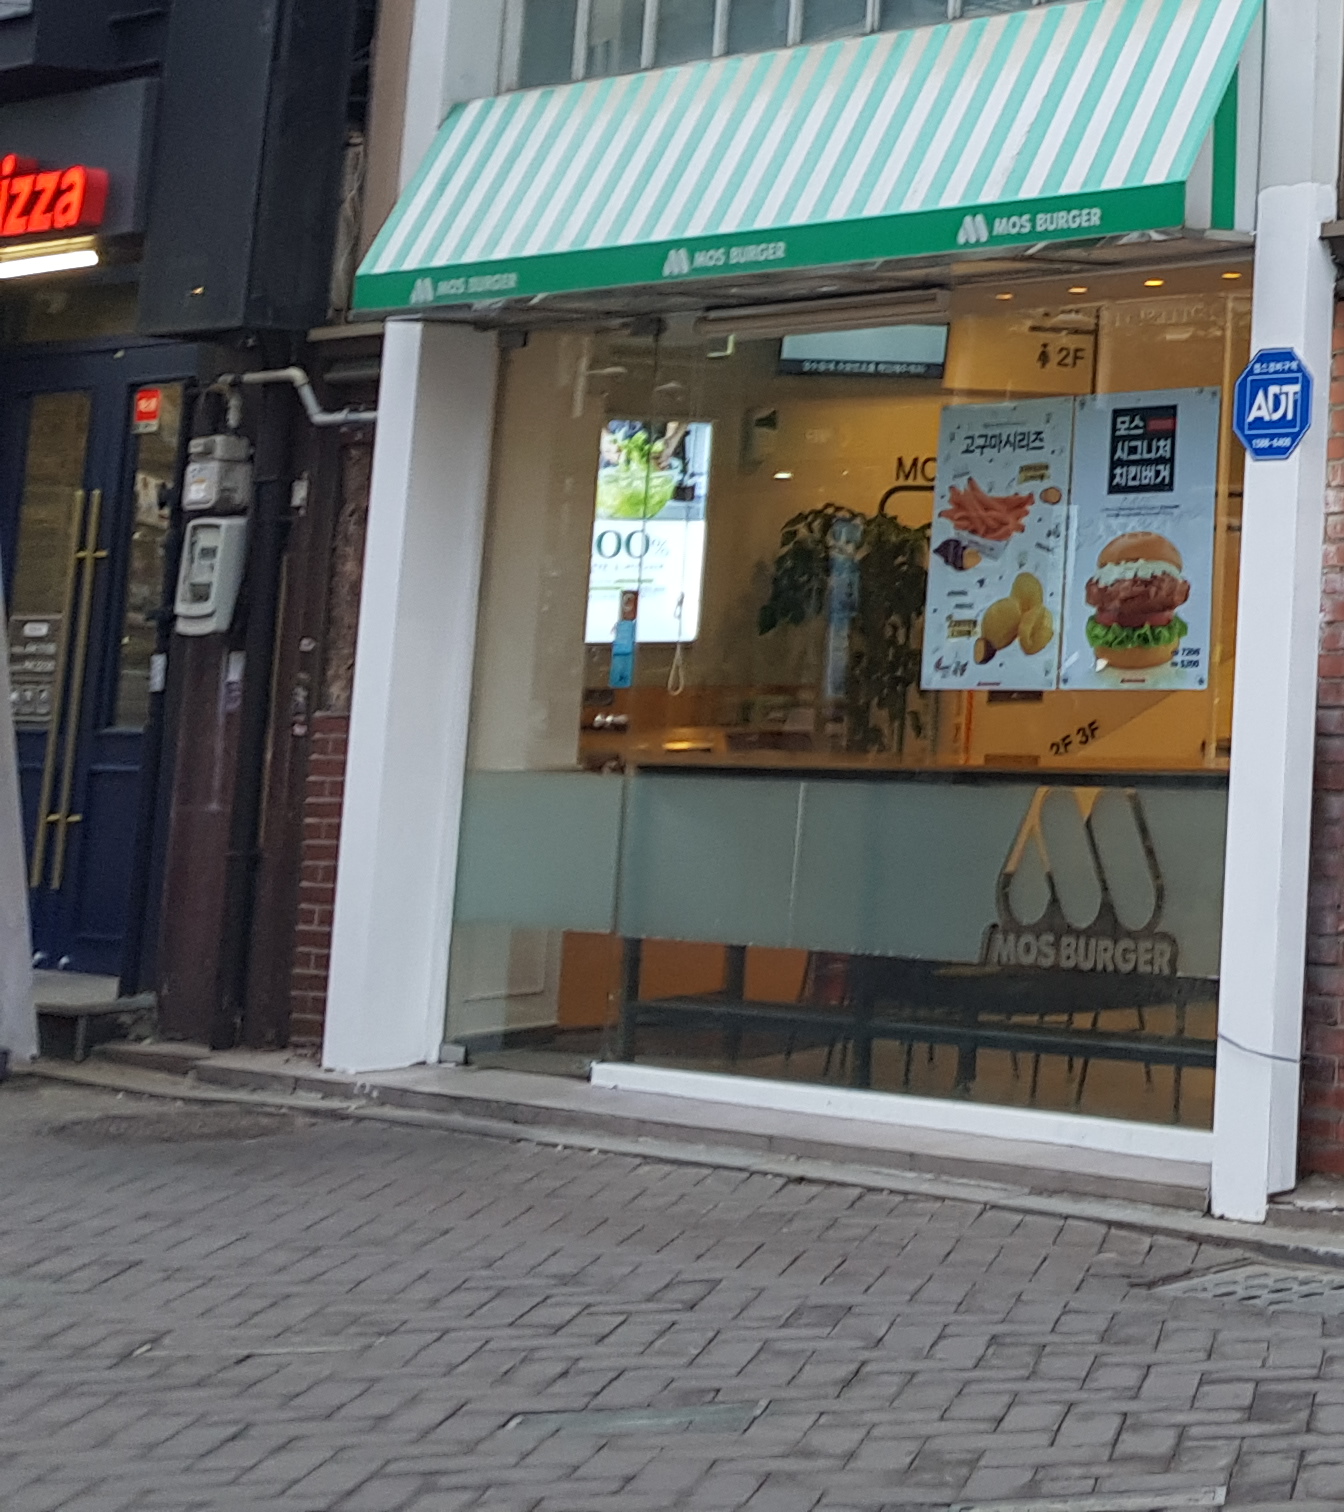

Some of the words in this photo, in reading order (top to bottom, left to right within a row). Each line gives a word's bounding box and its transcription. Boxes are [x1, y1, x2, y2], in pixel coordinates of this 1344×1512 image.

[993, 212, 1033, 237] MOS
[1035, 206, 1102, 233] BURGER
[692, 247, 726, 270] MOS
[728, 241, 787, 267] BURGER
[1057, 346, 1086, 368] 2F
[1247, 383, 1300, 423] ADT
[1115, 414, 1144, 436] 모스
[961, 429, 1046, 455] 고구마시리즈
[1114, 438, 1172, 462] 시그니처
[1112, 464, 1171, 488] 치킨버거
[1049, 734, 1075, 757] 2F
[1077, 719, 1101, 747] 3F
[993, 931, 1057, 968] MOS
[1059, 936, 1173, 976] BURGER
